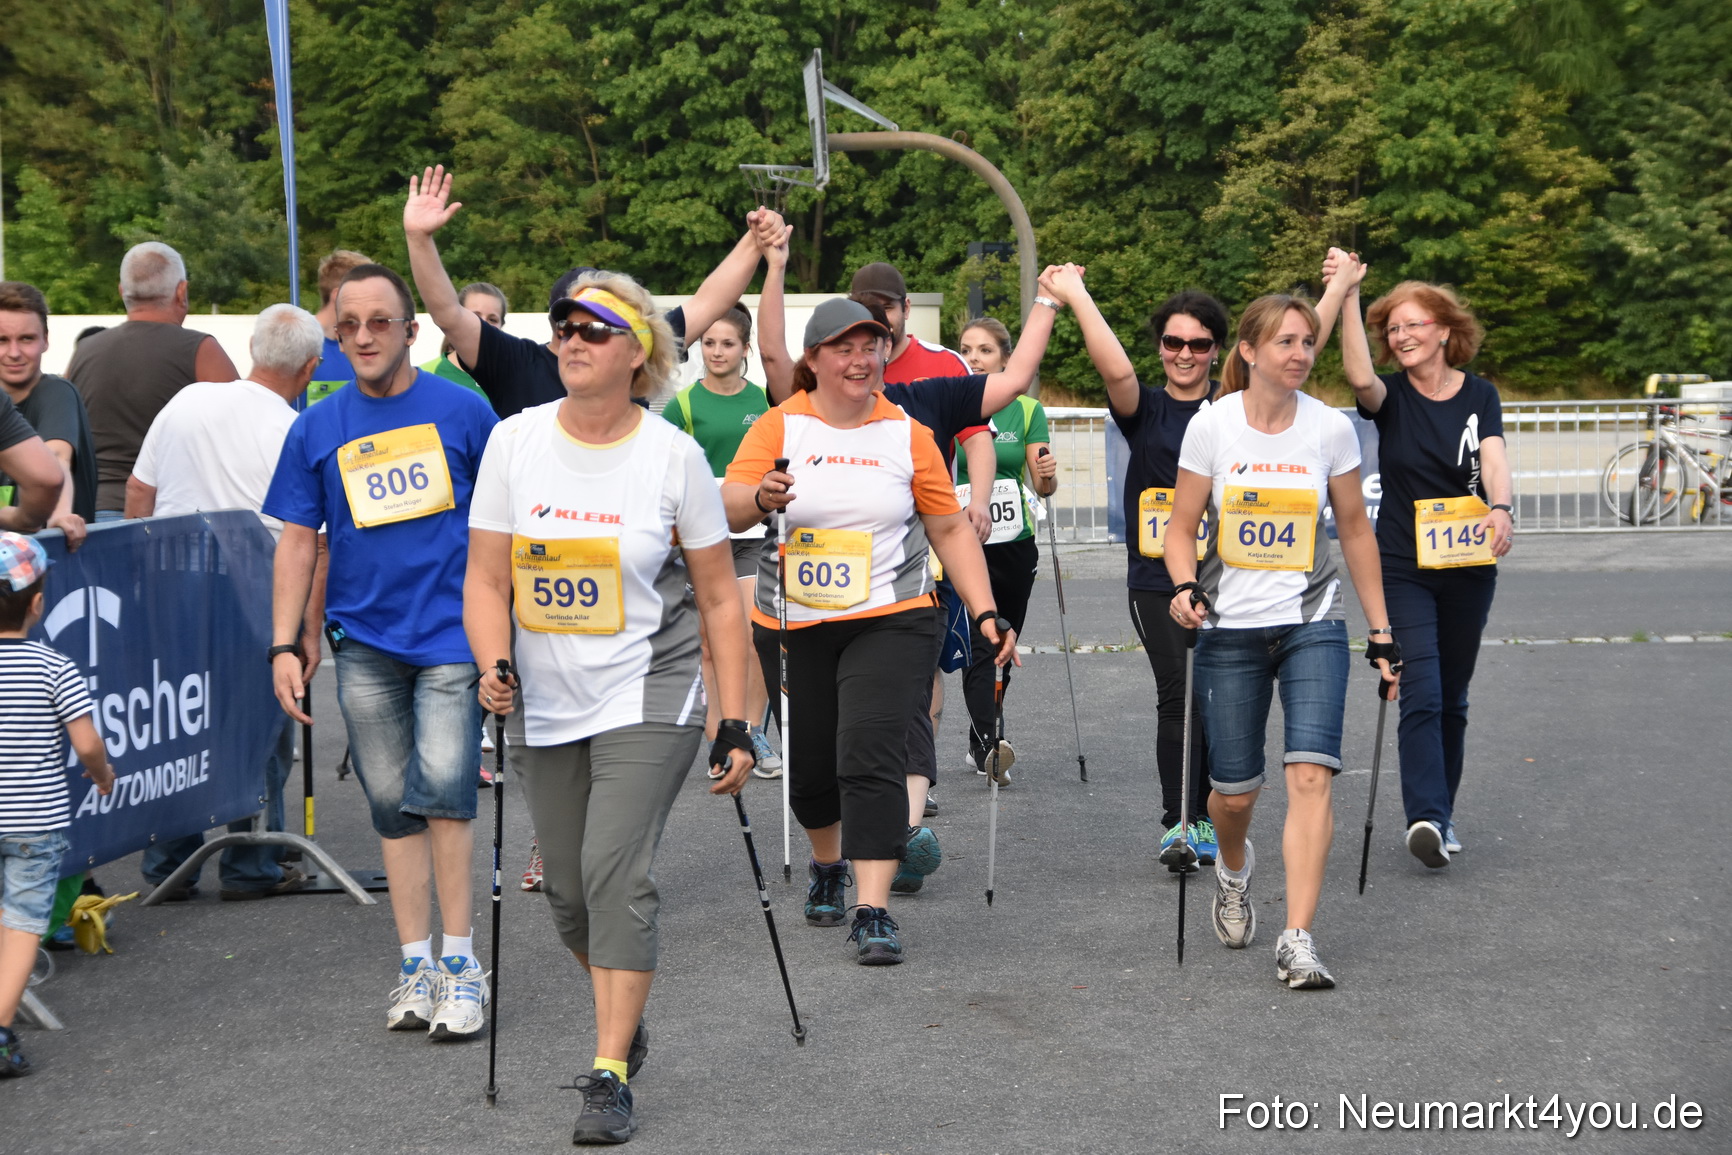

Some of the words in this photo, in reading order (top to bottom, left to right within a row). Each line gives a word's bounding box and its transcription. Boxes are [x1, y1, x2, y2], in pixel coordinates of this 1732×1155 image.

[997, 431, 1017, 440] AOK
[827, 456, 884, 467] KLEBL
[1252, 463, 1312, 475] KLEBL
[366, 462, 429, 500] 806
[555, 508, 624, 526] KLEBL
[1239, 521, 1296, 547] 604
[1426, 524, 1486, 549] 1149
[1247, 552, 1263, 560] Katja
[798, 561, 850, 588] 603
[534, 577, 598, 607] 599
[803, 591, 818, 600] Ingrid
[545, 613, 573, 621] Gerlinde
[75, 750, 209, 818] AUTOMOBILE
